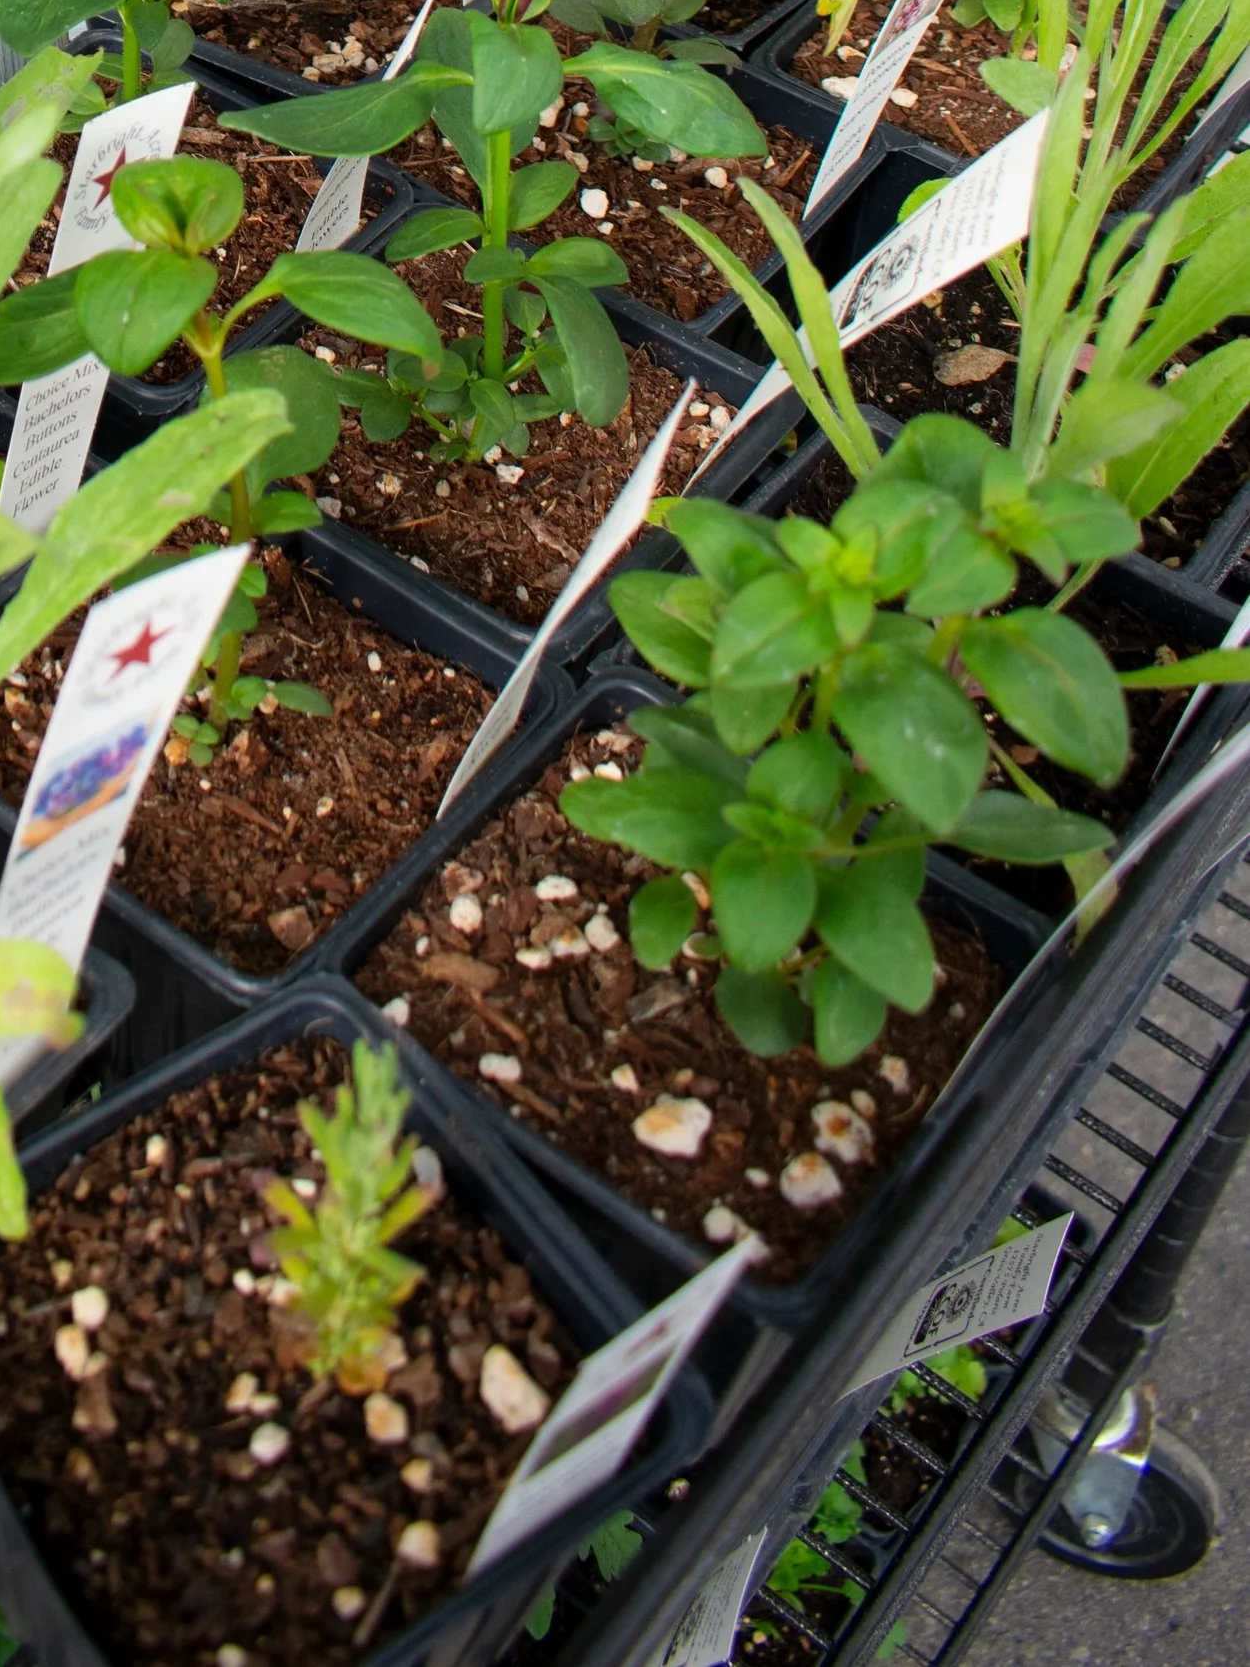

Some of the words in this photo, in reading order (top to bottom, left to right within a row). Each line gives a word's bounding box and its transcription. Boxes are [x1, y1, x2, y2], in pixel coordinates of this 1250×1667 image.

[140, 129, 161, 159] Acre
[25, 373, 71, 412] Choice
[72, 360, 100, 383] Mix
[23, 385, 91, 433] Bachelors
[25, 410, 78, 452] Buttons
[13, 428, 80, 479] Centaurea
[19, 457, 63, 495] Edible
[13, 478, 59, 519] Flower
[928, 1283, 958, 1337] CCOF
